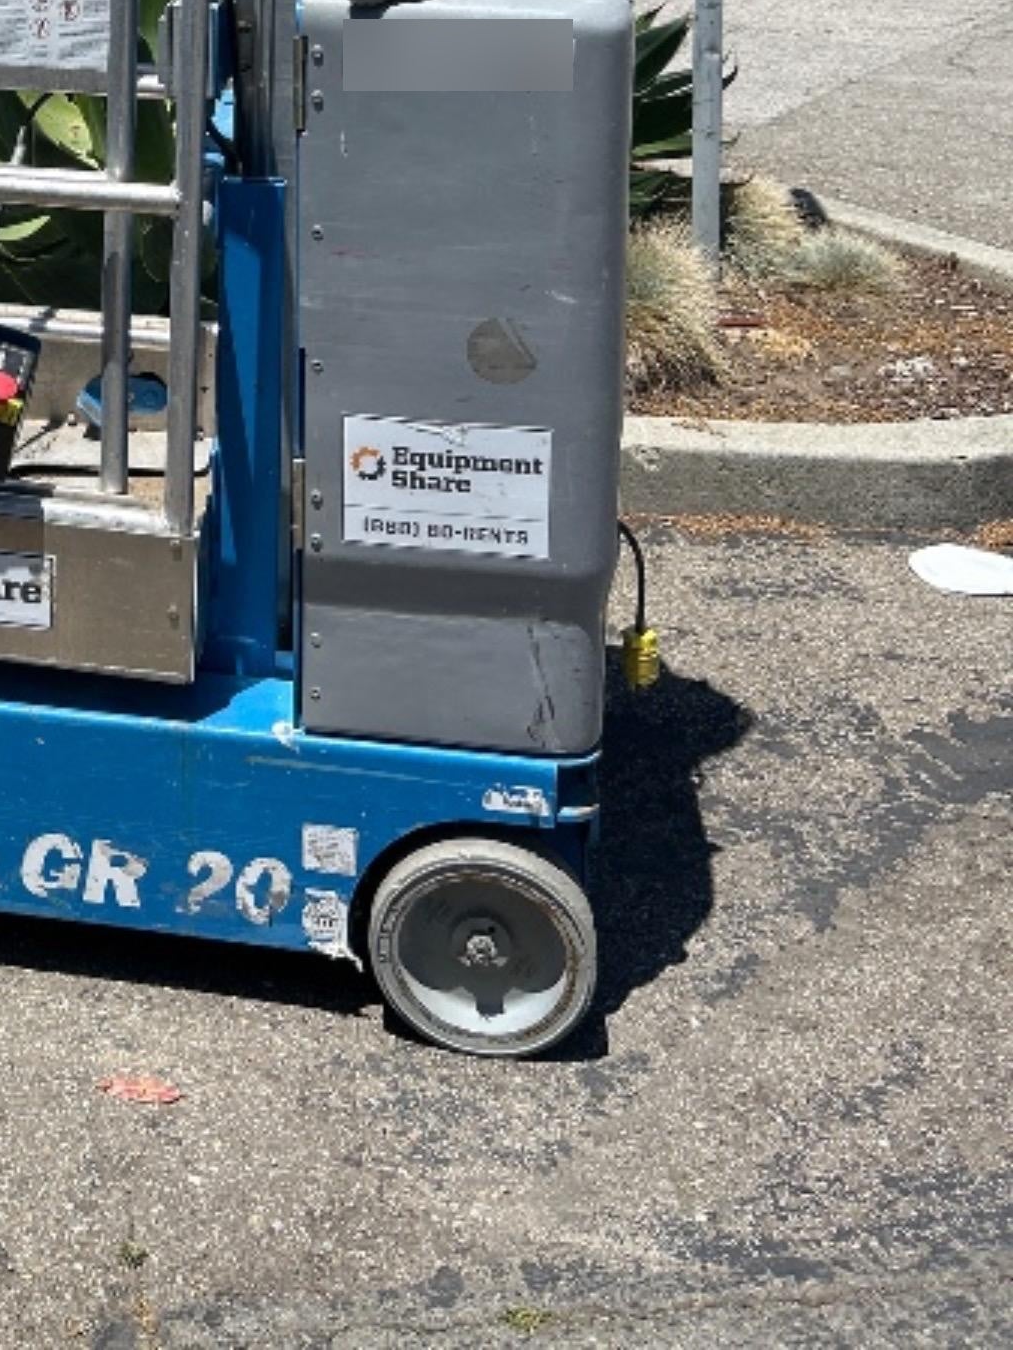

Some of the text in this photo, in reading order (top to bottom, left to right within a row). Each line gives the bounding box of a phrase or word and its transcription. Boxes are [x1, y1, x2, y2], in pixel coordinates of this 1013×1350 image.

[392, 446, 543, 475] Equipment
[392, 470, 471, 493] Share
[20, 833, 149, 908] GR
[175, 850, 292, 927] 20
